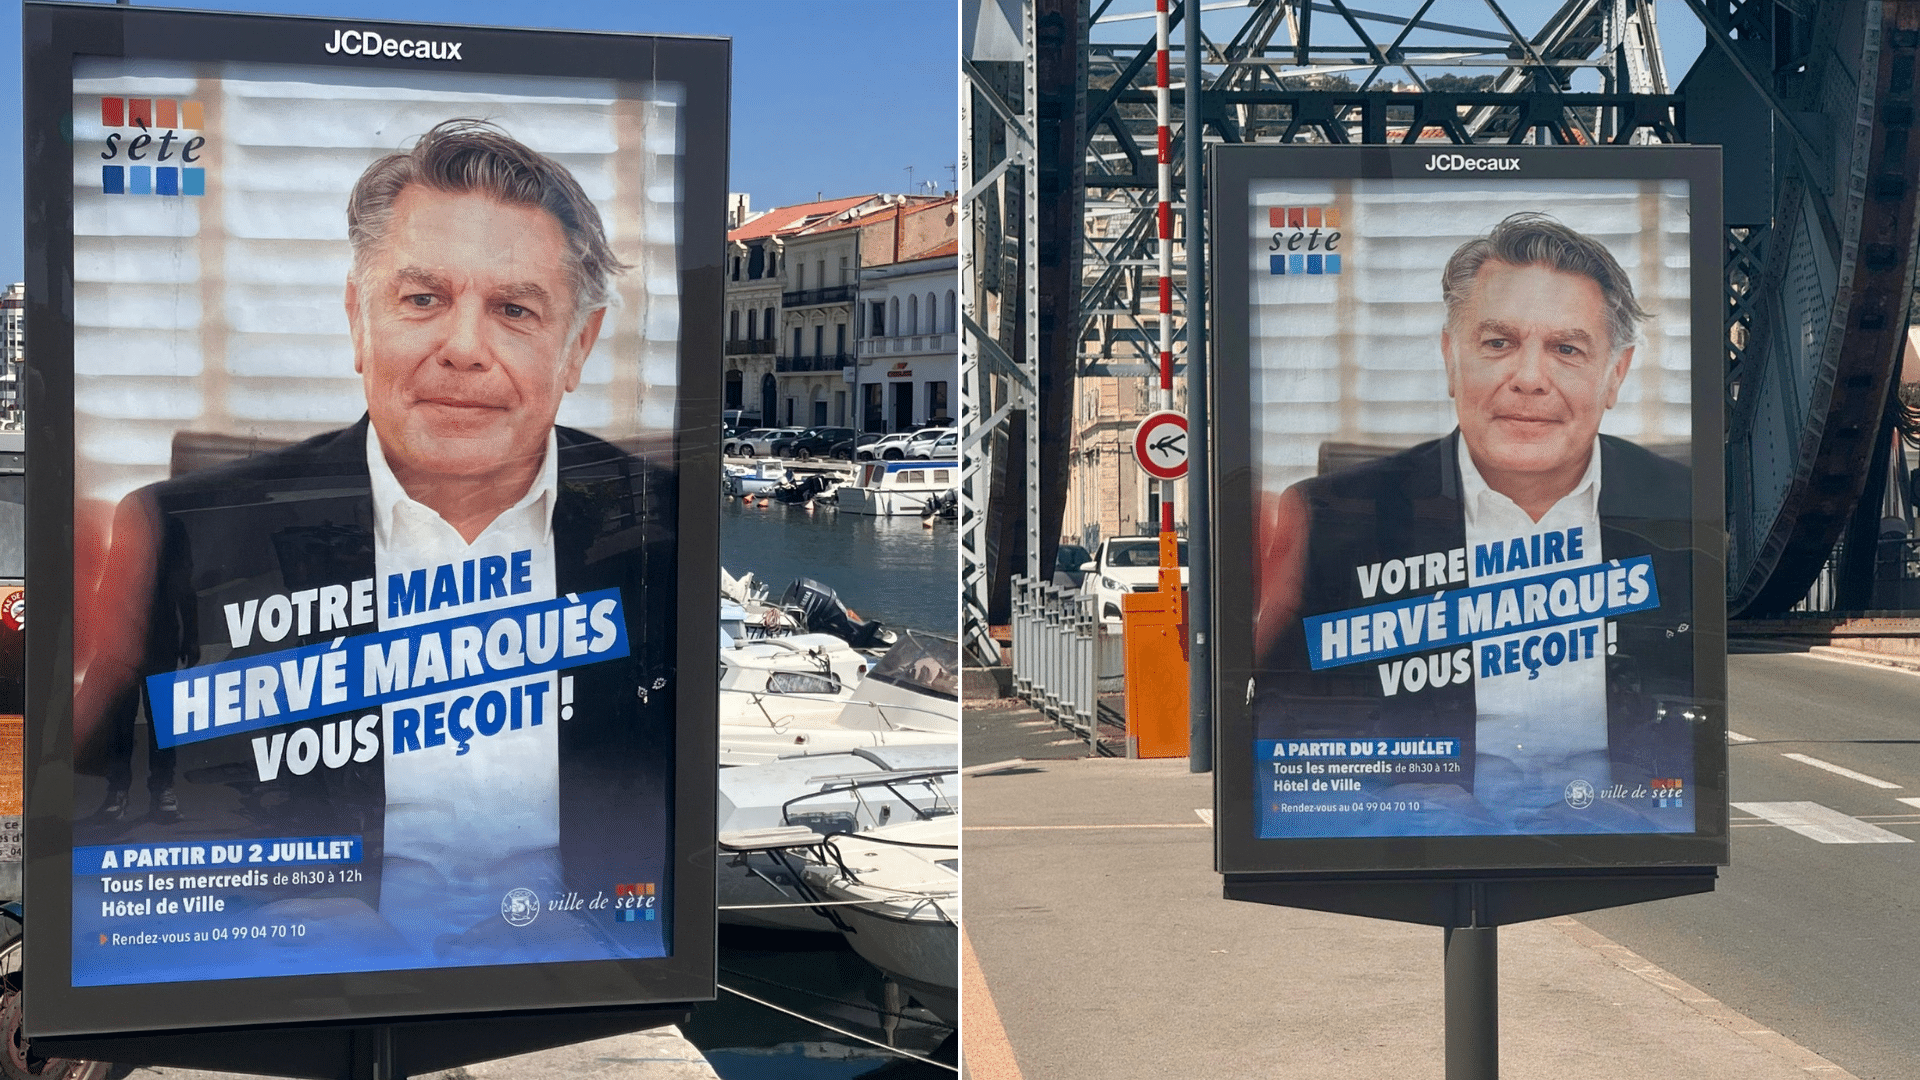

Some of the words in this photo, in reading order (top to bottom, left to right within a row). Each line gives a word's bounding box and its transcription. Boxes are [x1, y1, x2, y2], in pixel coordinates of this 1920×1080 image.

[324, 29, 463, 61] JCDecaux
[101, 117, 206, 163] sète
[1425, 154, 1521, 171] JCDecaux
[1269, 220, 1342, 251] sète
[1356, 547, 1466, 599] VOTRE
[1475, 526, 1584, 579] MAIRE
[223, 577, 374, 649] VOTRE
[387, 549, 532, 619] MAIRE
[1321, 590, 1447, 661] HERVÉ
[1457, 559, 1650, 636] MARQUÈS
[172, 637, 348, 736] HERVÉ
[363, 593, 618, 698] MARQUÈS
[1378, 647, 1472, 697] VOUS
[1481, 625, 1599, 681] REÇOIT
[251, 715, 380, 783] VOUS
[392, 681, 550, 757] REÇOIT
[1273, 743, 1285, 757] A
[1289, 742, 1347, 757] PARTIR
[1350, 742, 1373, 756] DU
[1377, 742, 1388, 755] 2
[1391, 741, 1454, 755] JUILLET
[1273, 762, 1303, 774] Tous
[1306, 761, 1325, 774] les
[1328, 761, 1392, 774] mercredis
[1395, 763, 1407, 773] de
[1408, 762, 1433, 773] 8h30
[1434, 763, 1440, 772] à
[1443, 762, 1460, 772] 12h
[1273, 779, 1308, 792] Hôtel
[1312, 779, 1328, 791] de
[1330, 779, 1361, 791] Ville
[1601, 785, 1628, 799] ville
[1631, 784, 1647, 798] de
[1651, 784, 1683, 798] sète
[1281, 803, 1337, 813] Rendez-vous
[1338, 804, 1350, 812] au
[1352, 802, 1364, 812] 04
[1366, 802, 1378, 812] 99
[1380, 802, 1392, 811] 04
[1394, 802, 1406, 811] 70
[1408, 802, 1420, 811] 10
[101, 851, 118, 869] A
[123, 846, 205, 868] PARTIR
[211, 845, 243, 864] DU
[249, 844, 262, 862] 2
[267, 841, 353, 862] JUILLET
[101, 877, 143, 893] Tous
[149, 874, 174, 891] les
[179, 870, 269, 890] mercredis
[273, 873, 289, 886] de
[292, 871, 325, 884] 8h30
[328, 871, 335, 883] à
[339, 870, 362, 882] 12h
[102, 899, 150, 917] Hôtel
[156, 898, 179, 915] de
[182, 896, 225, 913] Ville
[548, 892, 585, 911] ville
[588, 891, 609, 910] de
[615, 891, 655, 909] sète
[112, 931, 191, 946] Rendez-vous
[193, 932, 209, 942] au
[212, 928, 228, 941] 04
[231, 927, 248, 940] 99
[251, 926, 267, 938] 04
[270, 925, 287, 938] 70
[290, 924, 306, 937] 10
